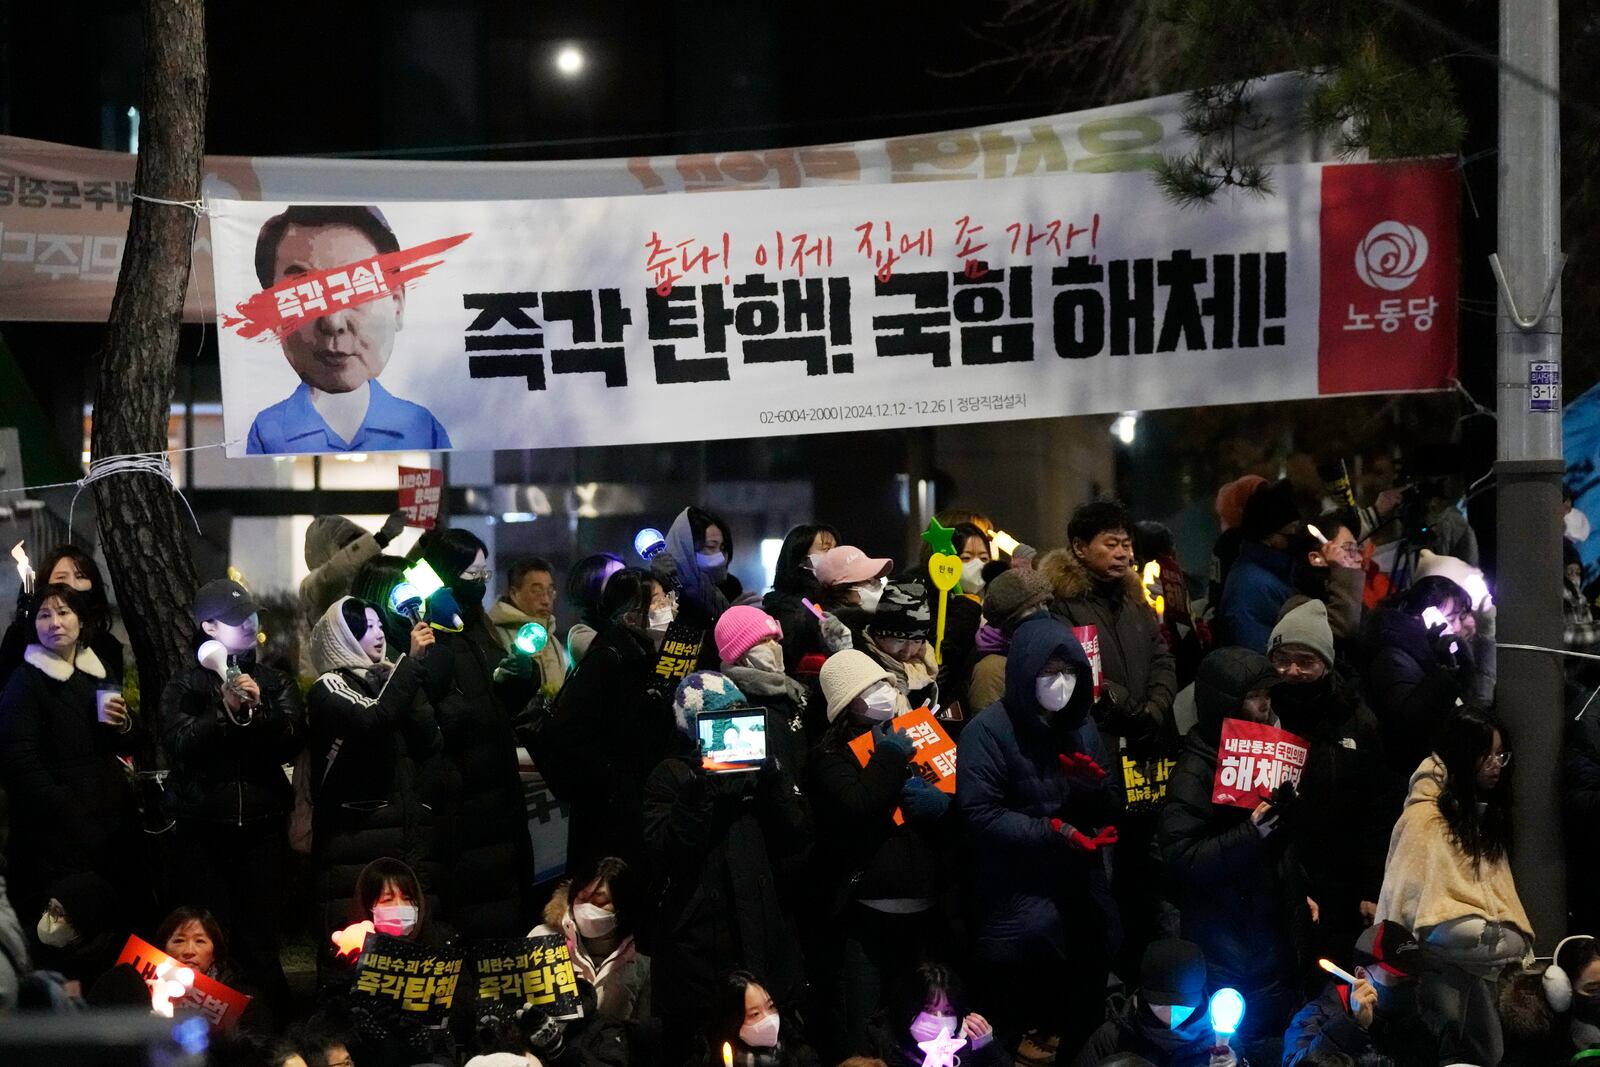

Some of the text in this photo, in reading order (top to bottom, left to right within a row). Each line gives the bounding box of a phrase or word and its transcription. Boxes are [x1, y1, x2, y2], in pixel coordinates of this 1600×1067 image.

[645, 213, 1100, 297] 춥다! 이제 집에 좀 가자!
[274, 261, 389, 319] 즉각 구속!
[463, 249, 1287, 391] 즉각 탄핵! 국힘 해체!
[1343, 296, 1439, 333] 노동당
[957, 394, 1027, 412] 정당직접설치
[1533, 386, 1557, 399] 3-12
[1224, 738, 1306, 765] 내란동조 국민의힘
[363, 953, 463, 975] 내란수괴 윤석열
[477, 944, 571, 974] 내란수괴 윤석열
